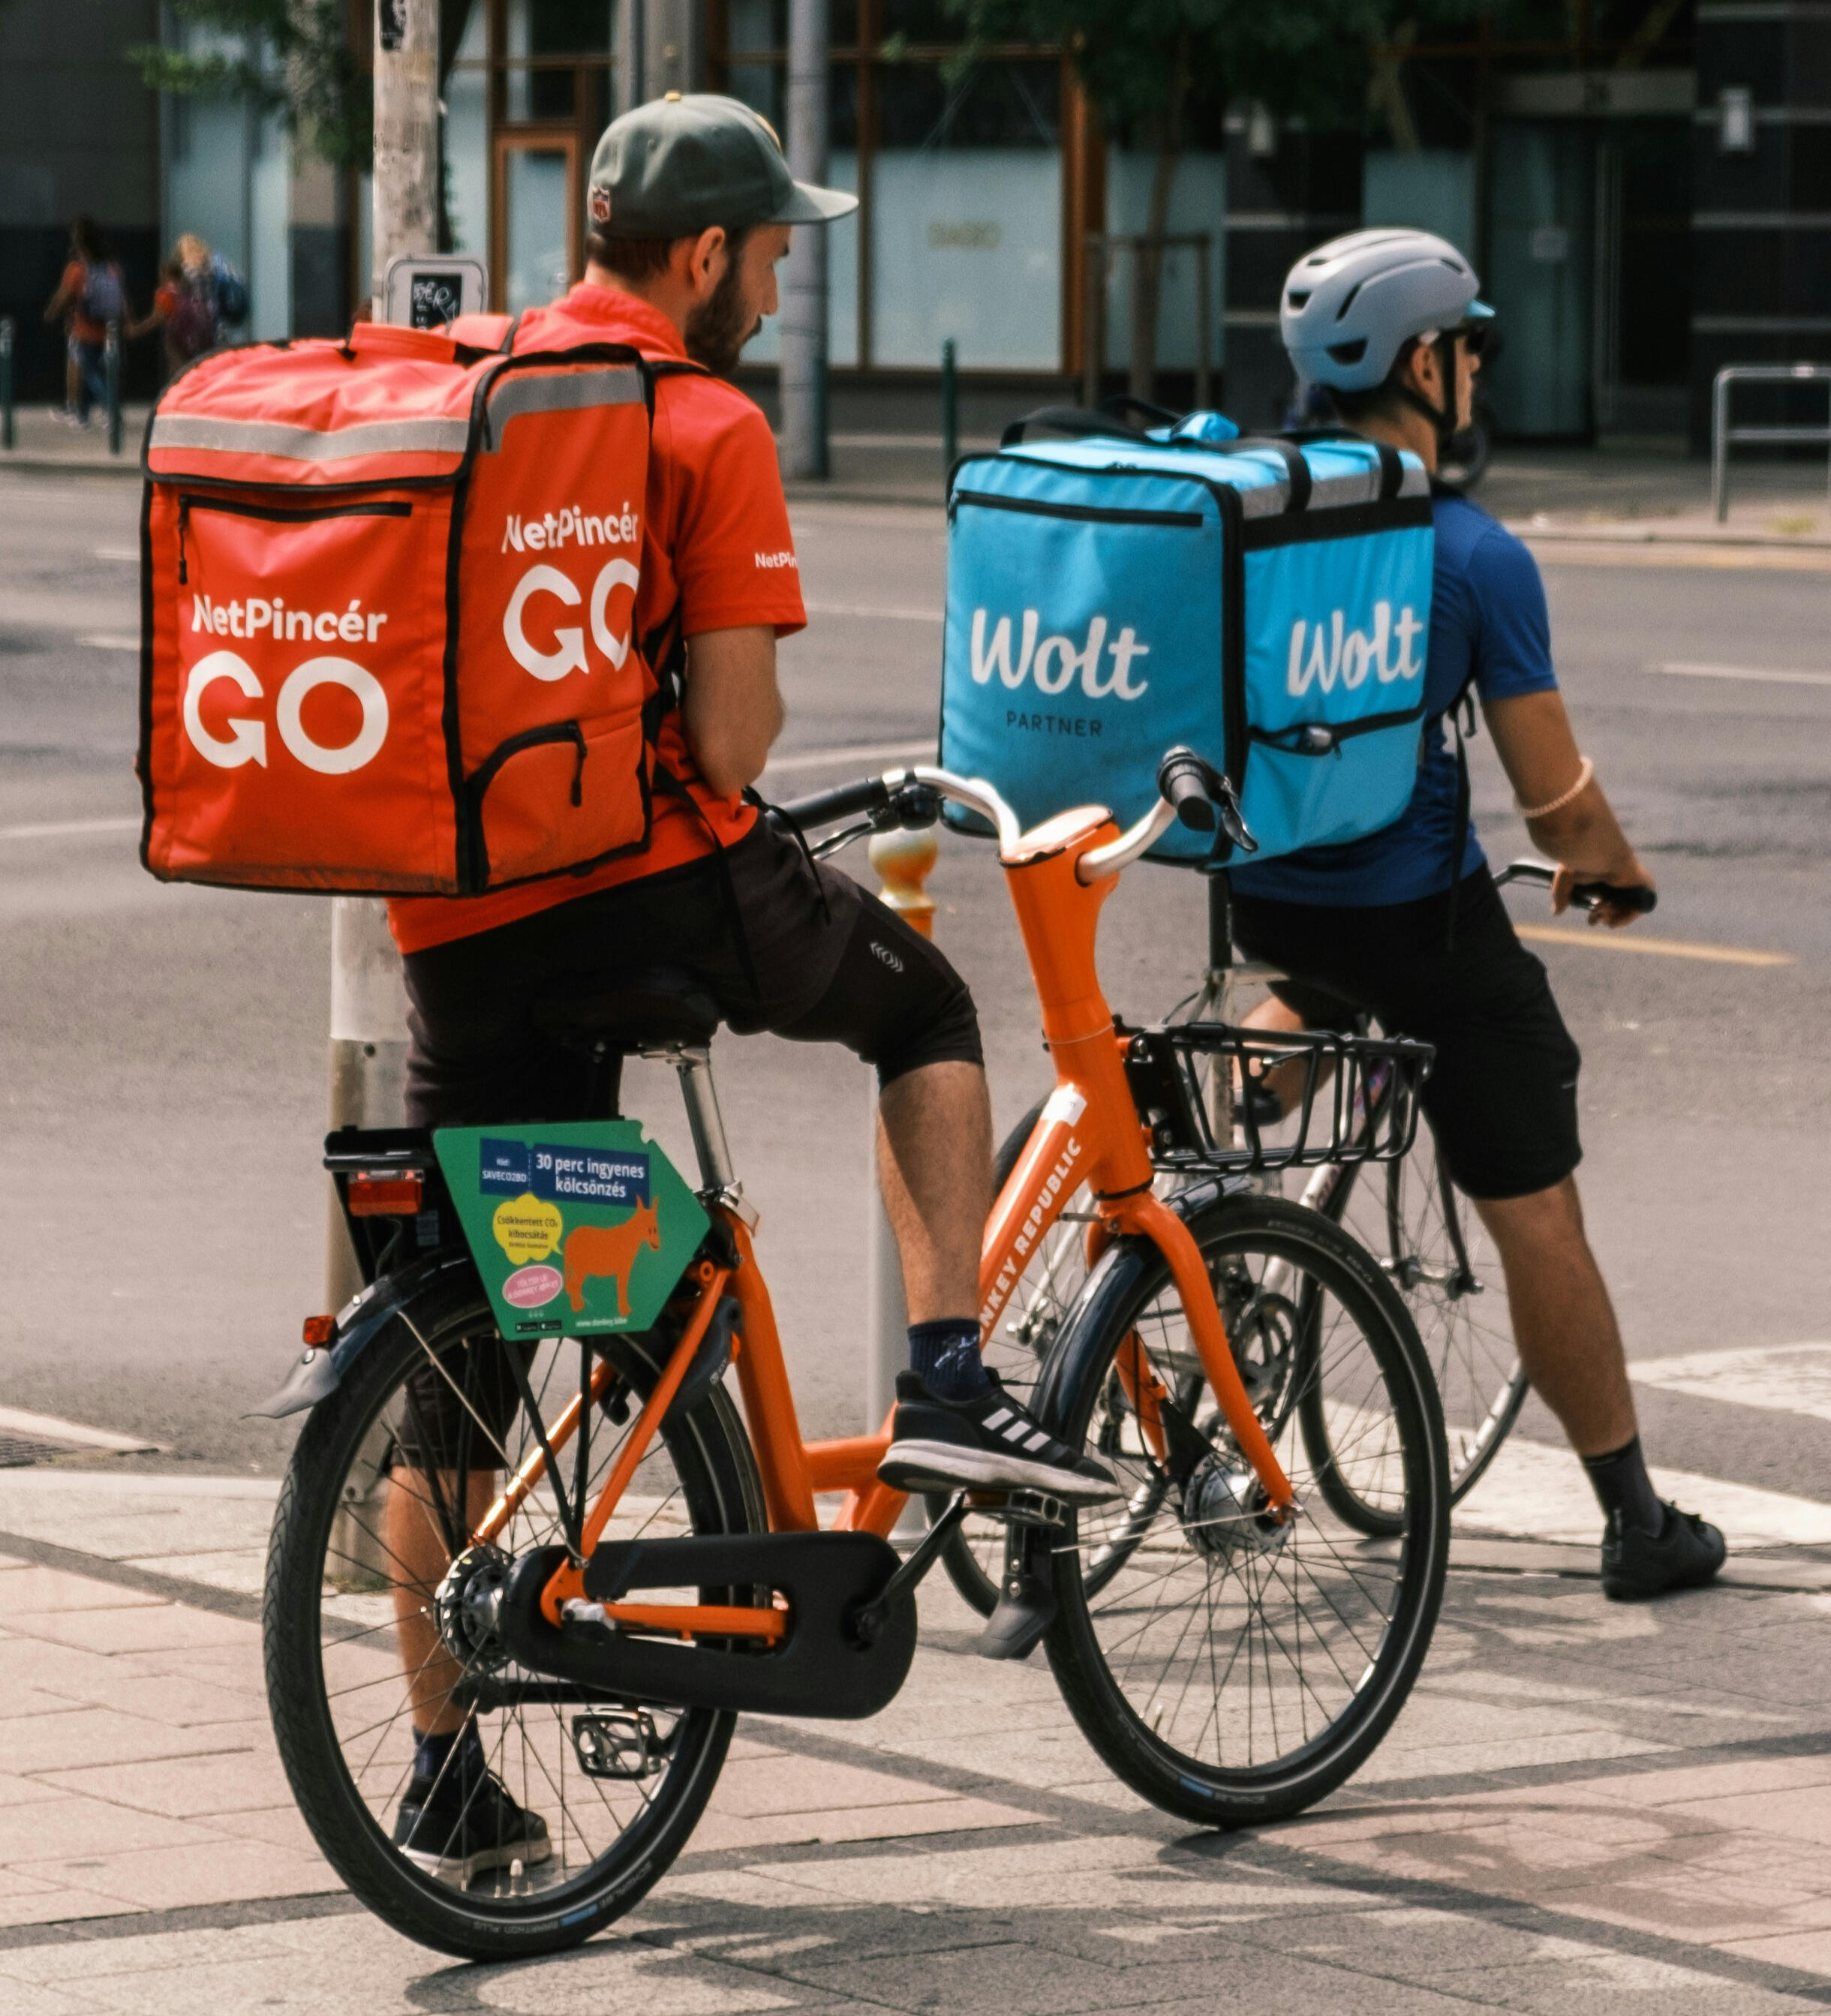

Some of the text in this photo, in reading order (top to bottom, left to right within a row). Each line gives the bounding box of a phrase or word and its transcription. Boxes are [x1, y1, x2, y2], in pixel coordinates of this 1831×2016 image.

[501, 501, 639, 554] NetPincér
[192, 593, 387, 642] NetPincér
[504, 558, 639, 682] GO
[1288, 602, 1424, 697] Wolt
[971, 608, 1150, 701] Wolt
[184, 650, 389, 774] GO
[1007, 711, 1102, 737] PARTNER
[536, 1154, 645, 1179] 30 perc ingyenes
[555, 1176, 627, 1198] kölcsönzés
[979, 1137, 1081, 1345] NKEY REPUBLIC
